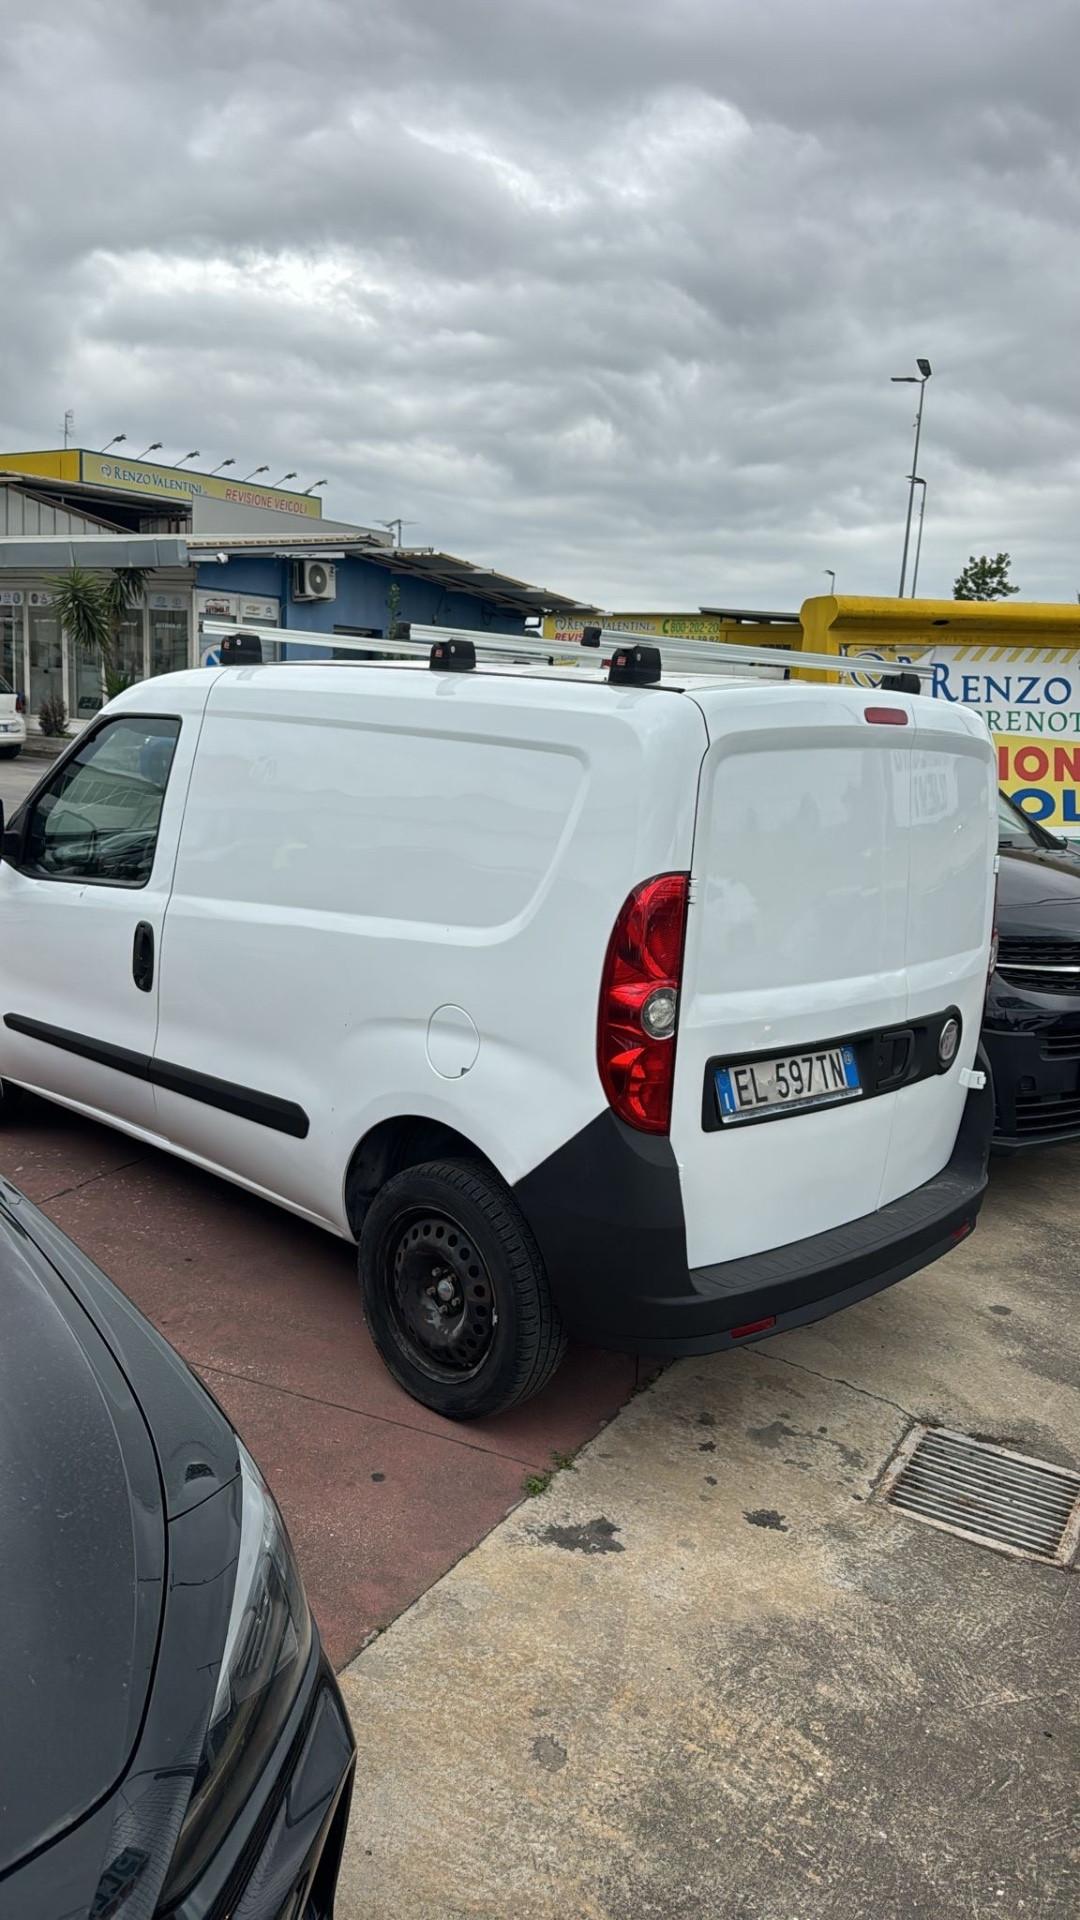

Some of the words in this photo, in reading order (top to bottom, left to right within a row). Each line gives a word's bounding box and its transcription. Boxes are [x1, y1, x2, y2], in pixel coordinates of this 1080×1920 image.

[114, 466, 150, 484] RENZO
[152, 474, 202, 493] VALENTINI
[225, 488, 272, 508] REVISIONE
[274, 498, 308, 514] VEICOLI
[671, 621, 720, 633] 800-202-20
[930, 663, 1072, 705] RENZO
[976, 710, 1080, 732] RENOT
[734, 1067, 768, 1107] EL
[775, 1053, 846, 1099] 597TN
